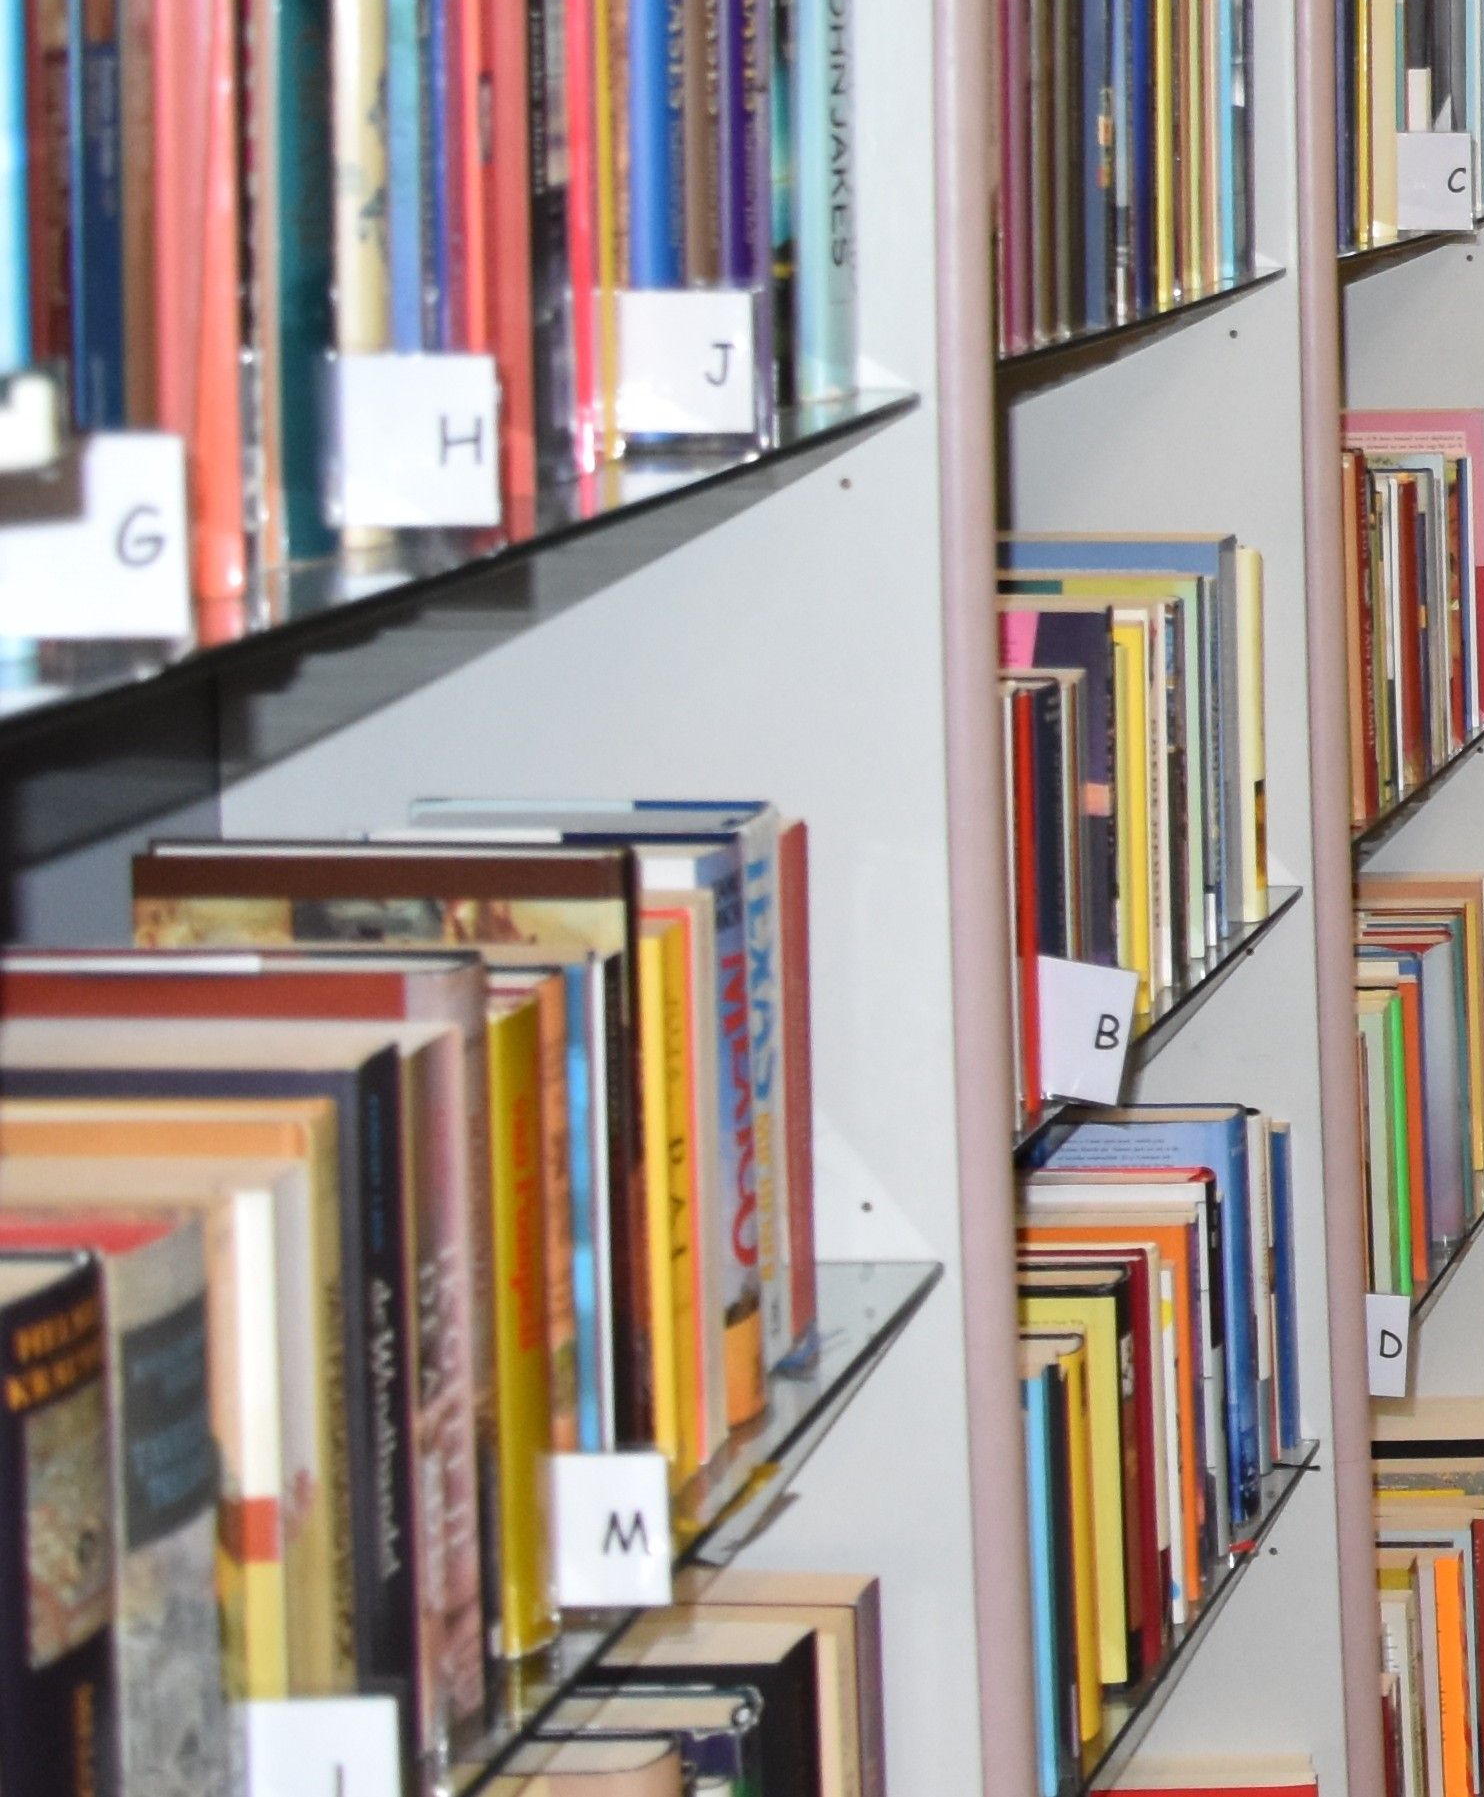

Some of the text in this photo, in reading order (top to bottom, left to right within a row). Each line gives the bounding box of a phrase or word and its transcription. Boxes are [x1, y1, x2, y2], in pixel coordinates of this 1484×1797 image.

[826, 104, 850, 272] JAKES
[1447, 167, 1467, 194] C
[704, 340, 737, 388] J
[439, 414, 484, 467] H
[112, 504, 169, 569] G
[1092, 1012, 1122, 1051] B
[1378, 1328, 1403, 1358] D
[602, 1509, 651, 1555] M
